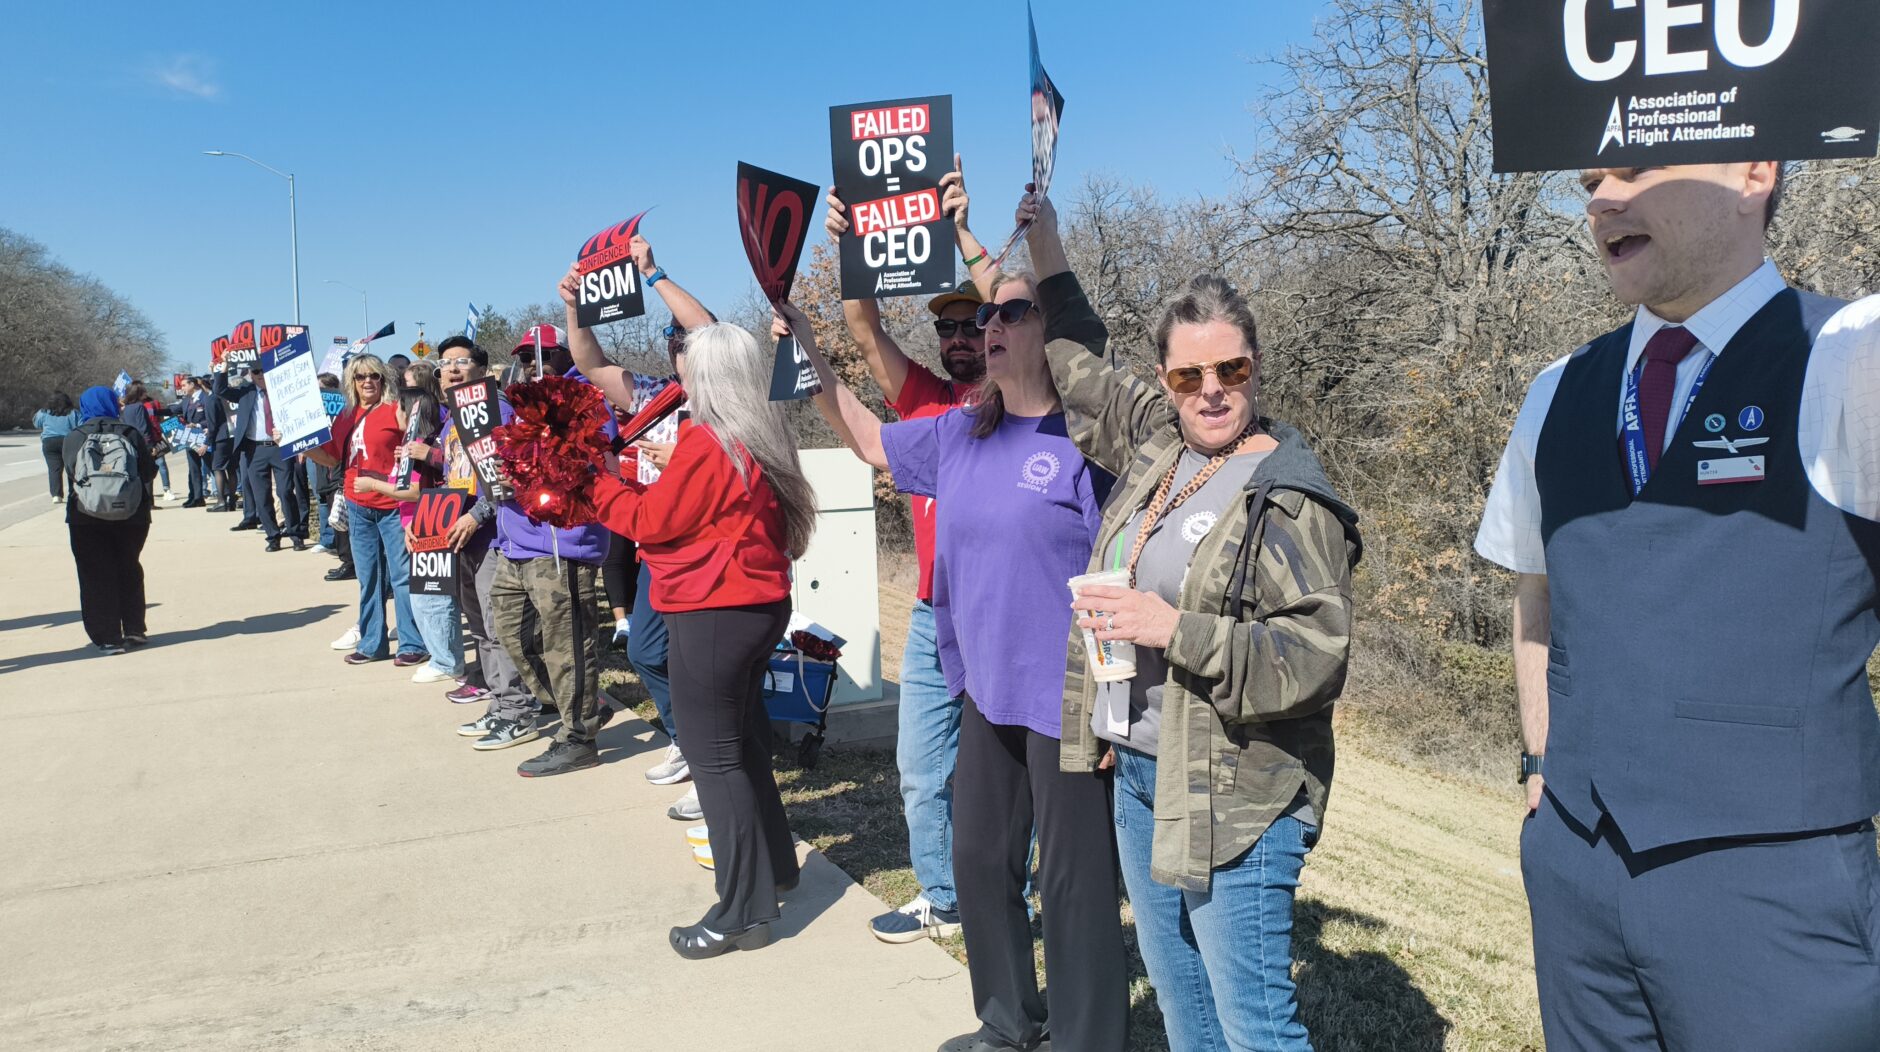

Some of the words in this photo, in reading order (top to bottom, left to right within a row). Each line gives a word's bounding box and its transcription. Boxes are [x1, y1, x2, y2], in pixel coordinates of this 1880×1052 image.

[1563, 0, 1800, 82] CEO
[1628, 90, 1716, 110] Association
[1719, 87, 1738, 105] of
[853, 107, 926, 138] FAILED
[1628, 106, 1721, 127] Professional
[1627, 128, 1669, 147] Flight
[1672, 123, 1755, 141] Attendants
[858, 135, 927, 177] OPS
[854, 192, 936, 234] FAILED
[580, 245, 623, 271] CONFIDENCE
[863, 225, 931, 268] CEO
[580, 262, 636, 305] ISOM
[211, 337, 229, 360] NO
[260, 325, 282, 347] NO
[228, 349, 257, 362] SOM
[277, 383, 295, 400] PLAYS
[296, 375, 311, 390] GOLF
[455, 383, 486, 407] FAILED
[276, 408, 288, 422] WE
[460, 402, 489, 429] OPS
[1624, 392, 1640, 431] APFA
[282, 422, 295, 438] PAY
[295, 416, 306, 431] THE
[292, 436, 319, 452] APFA.org
[1629, 438, 1638, 475] PROFESSIONAL
[413, 493, 461, 536] NO
[412, 552, 452, 577] ISOM
[1102, 640, 1114, 666] BROS
